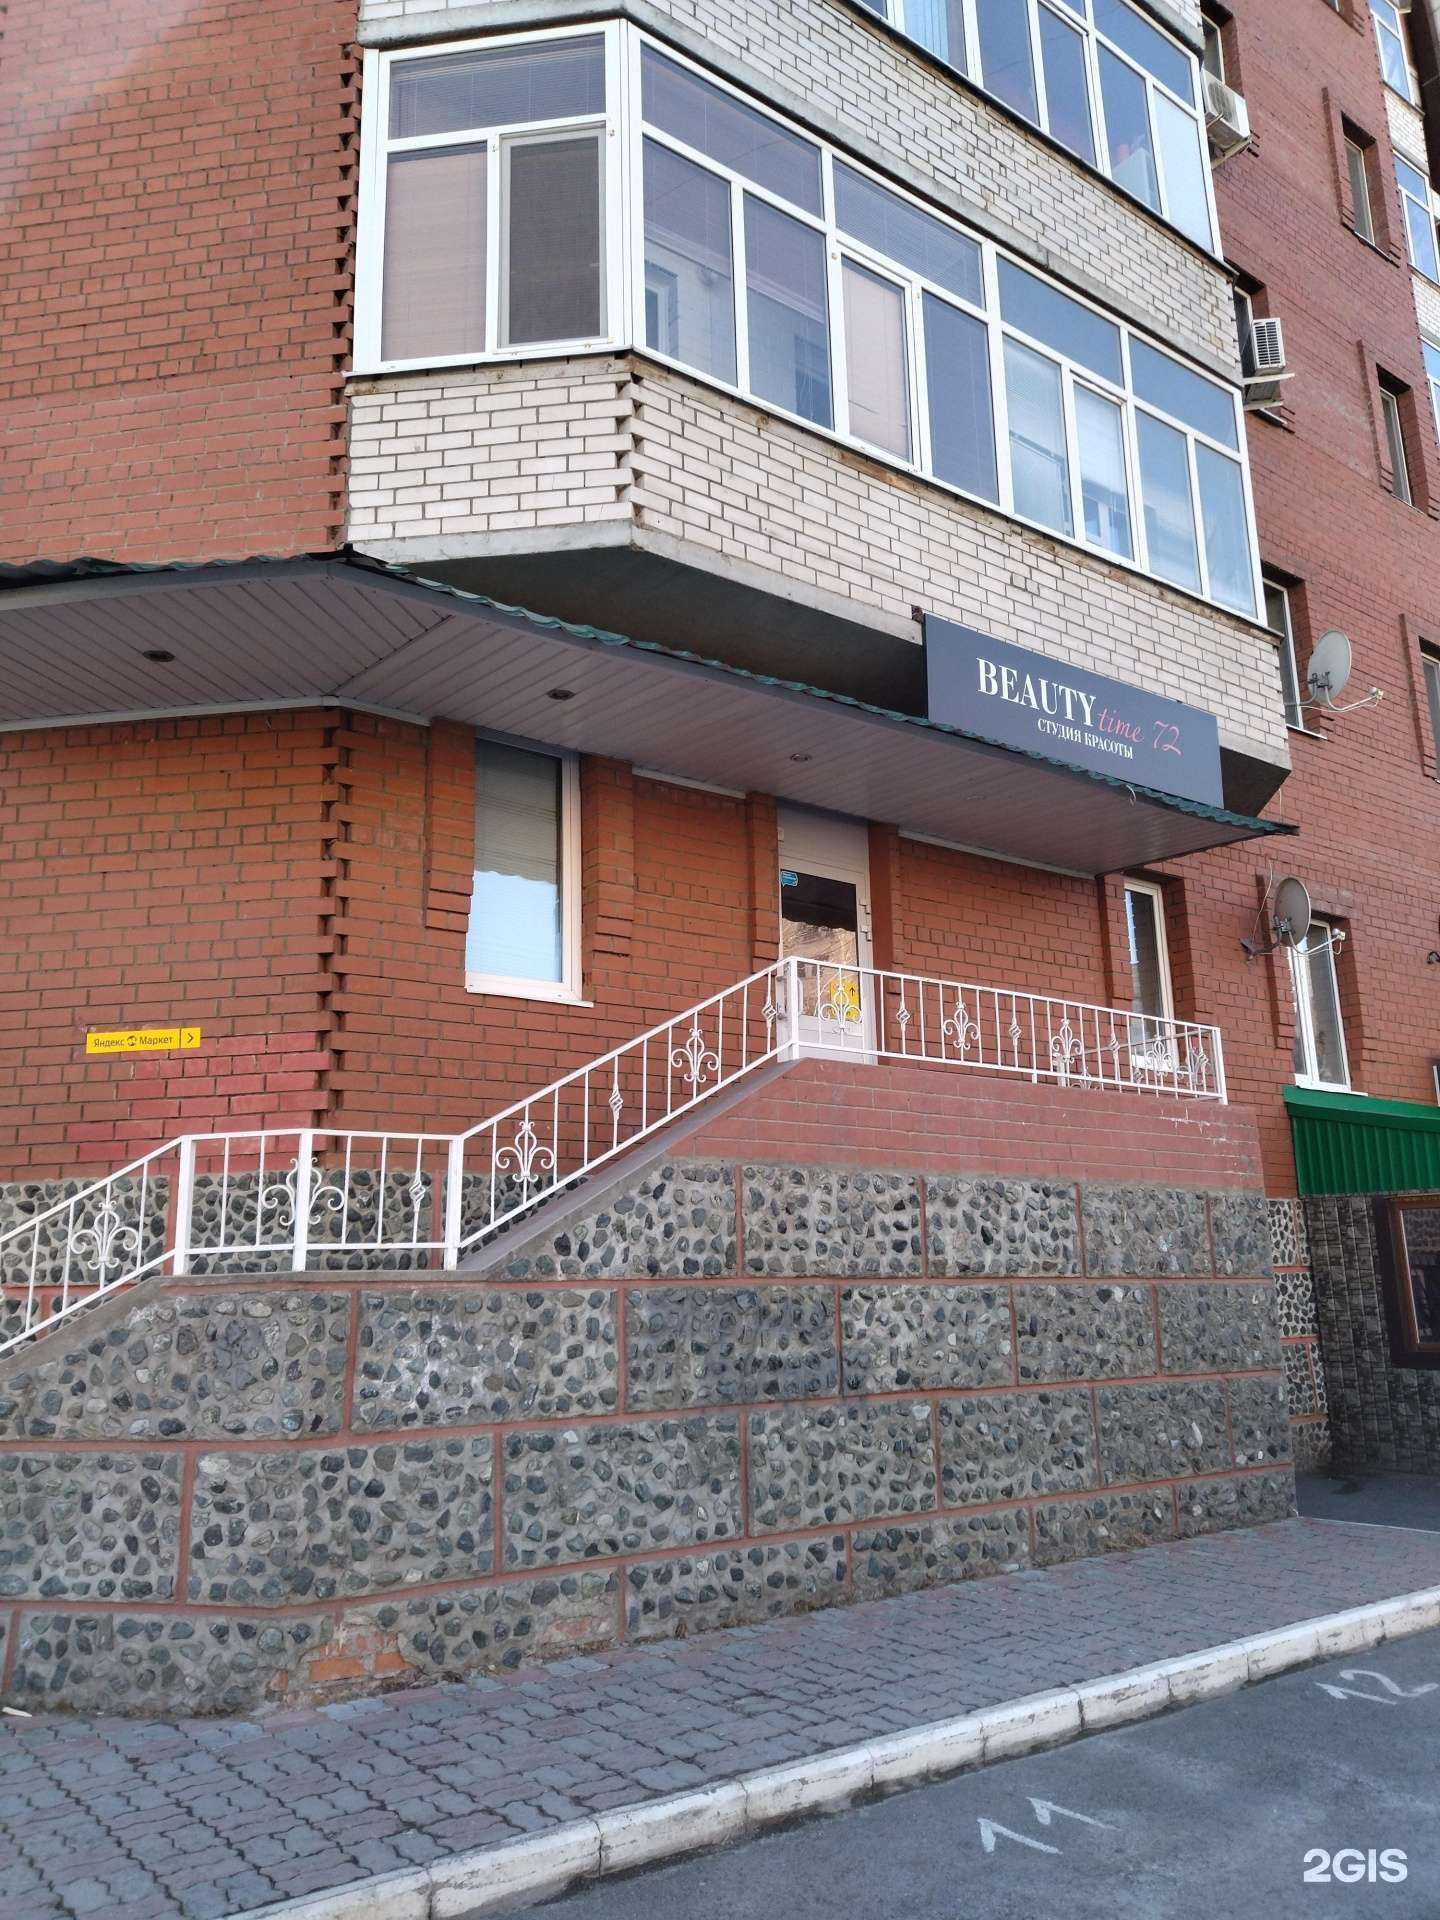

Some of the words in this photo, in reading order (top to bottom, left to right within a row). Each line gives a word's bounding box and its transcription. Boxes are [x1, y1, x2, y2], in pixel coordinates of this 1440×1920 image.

[976, 658, 1096, 726] BEAUTY
[1098, 707, 1144, 743] time
[1153, 720, 1182, 756] 72
[1037, 718, 1082, 743] СТУДИЯ
[1084, 732, 1133, 760] КРАСОТЫ
[94, 1038, 124, 1048] Яндекс
[139, 1036, 173, 1045] Маркет
